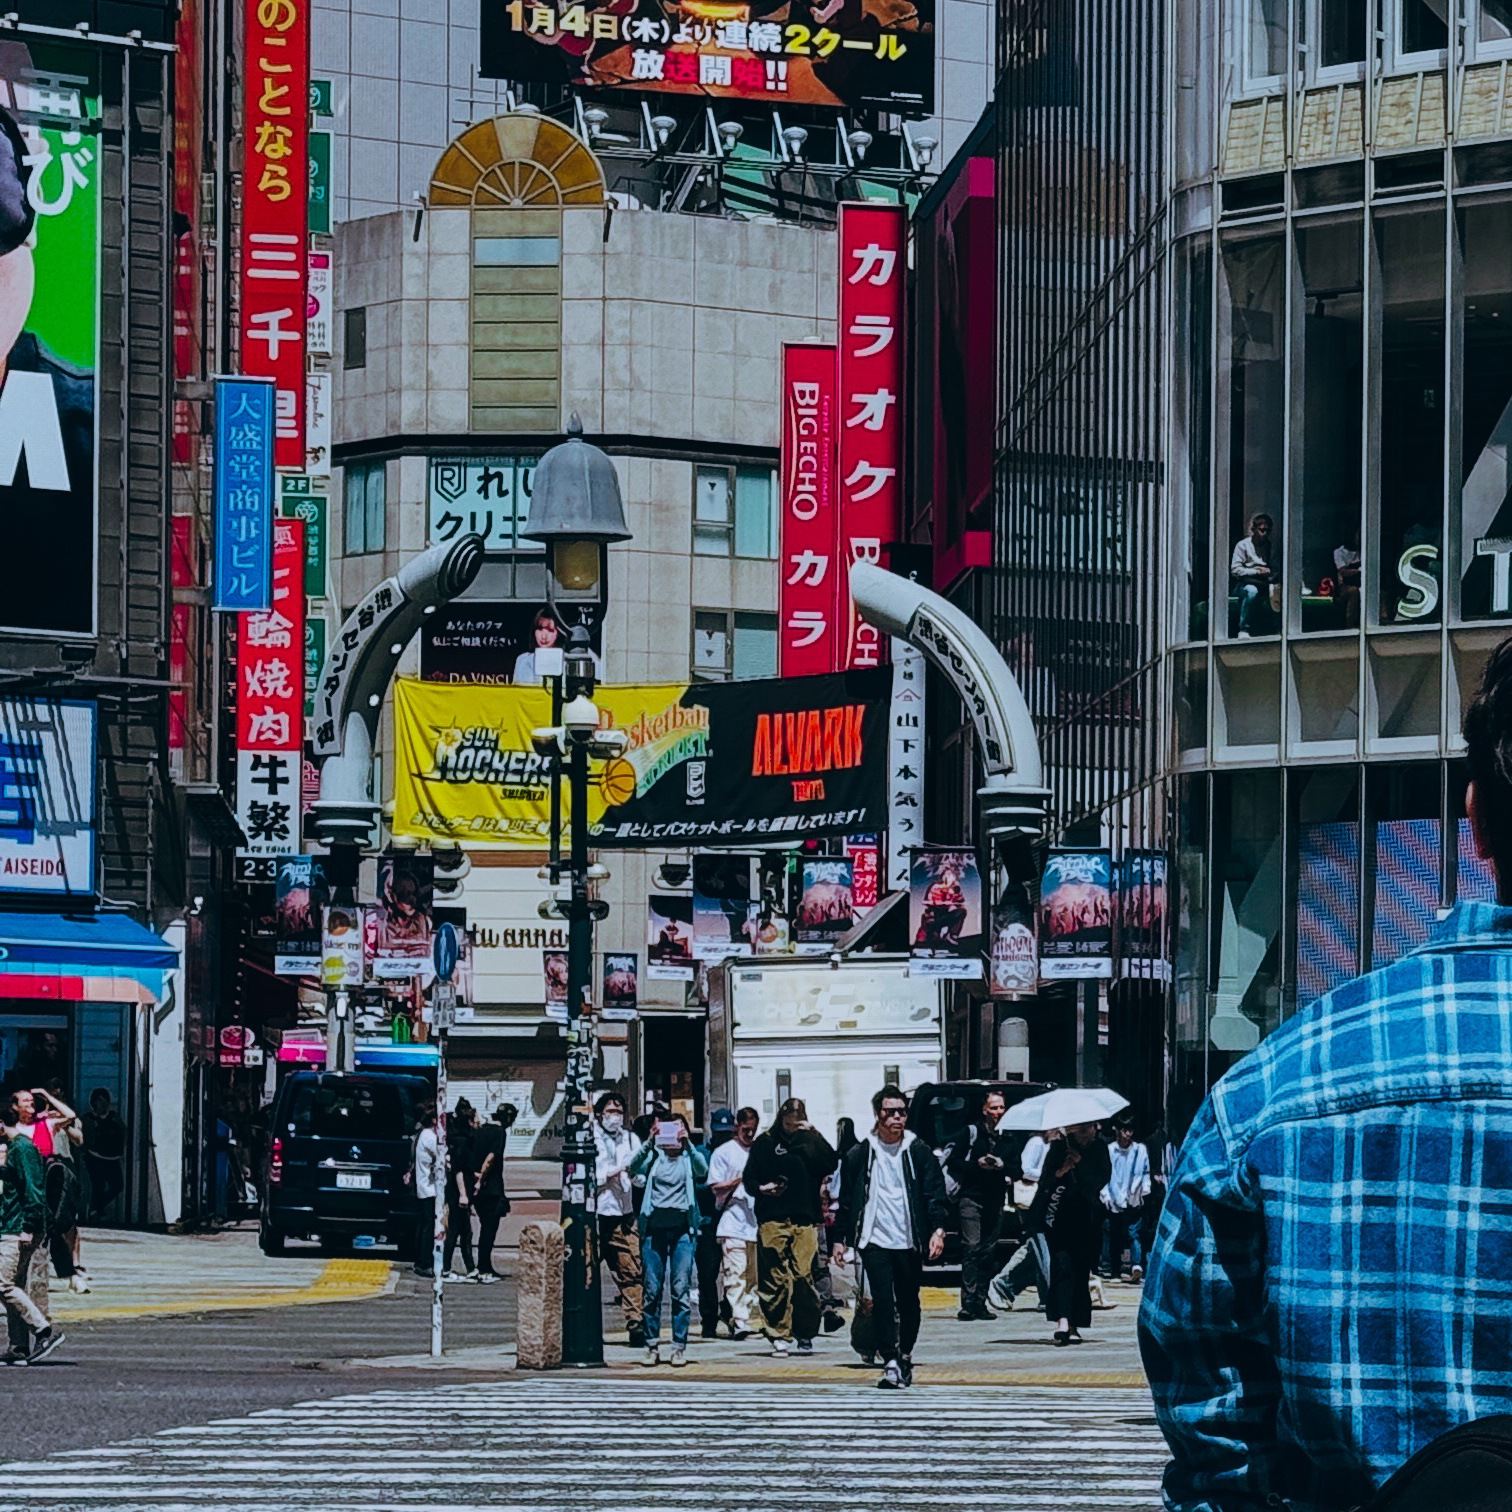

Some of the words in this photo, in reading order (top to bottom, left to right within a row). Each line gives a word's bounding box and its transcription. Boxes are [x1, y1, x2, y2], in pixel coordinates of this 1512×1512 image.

[845, 243, 896, 502] カラオケ
[792, 382, 819, 436] BIG
[227, 392, 263, 597] 大盛堂商事ビル
[286, 479, 308, 491] 2F
[791, 441, 818, 521] ECHO
[463, 726, 499, 747] SUN
[751, 703, 866, 777] ALVARK
[436, 747, 553, 784] ROCKERS
[0, 857, 66, 877] AISEIDO
